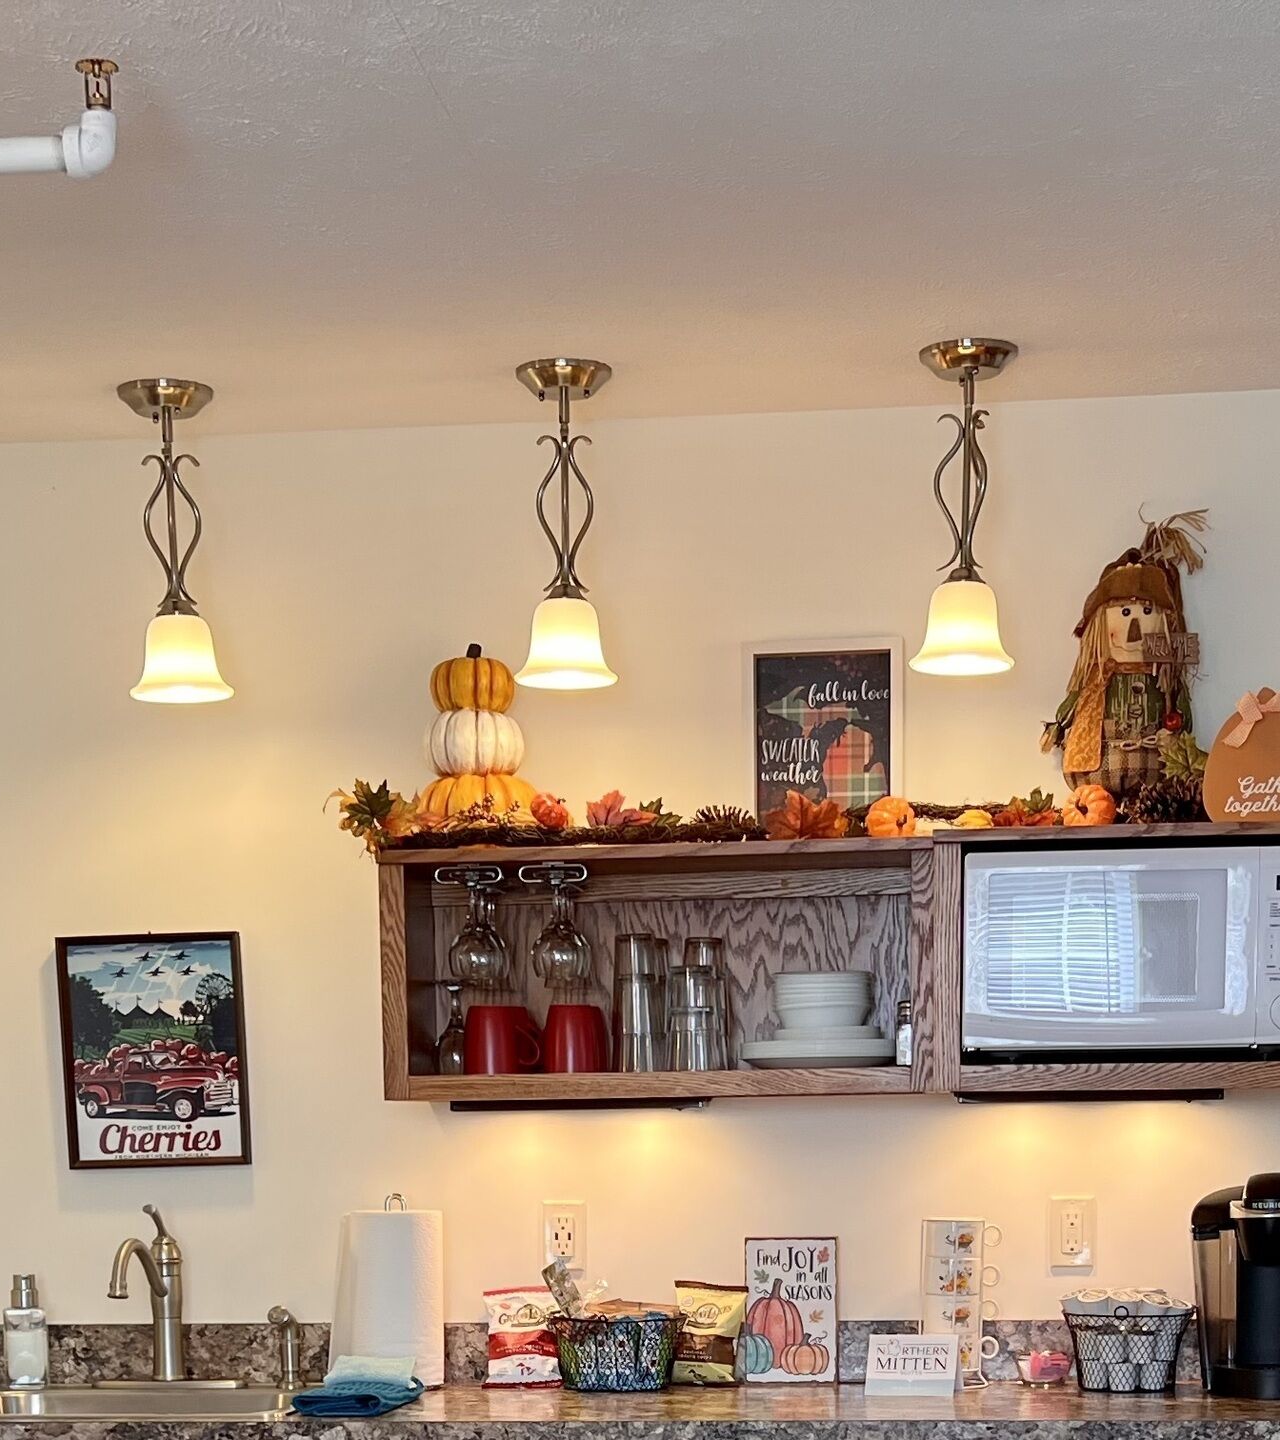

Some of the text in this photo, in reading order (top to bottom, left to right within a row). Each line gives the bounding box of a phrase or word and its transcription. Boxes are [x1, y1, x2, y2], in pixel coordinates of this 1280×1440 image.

[808, 679, 889, 708] fall in love
[761, 737, 820, 765] SWEATER
[760, 762, 821, 785] weather
[99, 1123, 222, 1154] Cherries
[756, 1246, 817, 1273] Find JOY
[795, 1267, 828, 1283] in all
[784, 1284, 833, 1301] SEASONS
[875, 1357, 948, 1371] MITTEN
